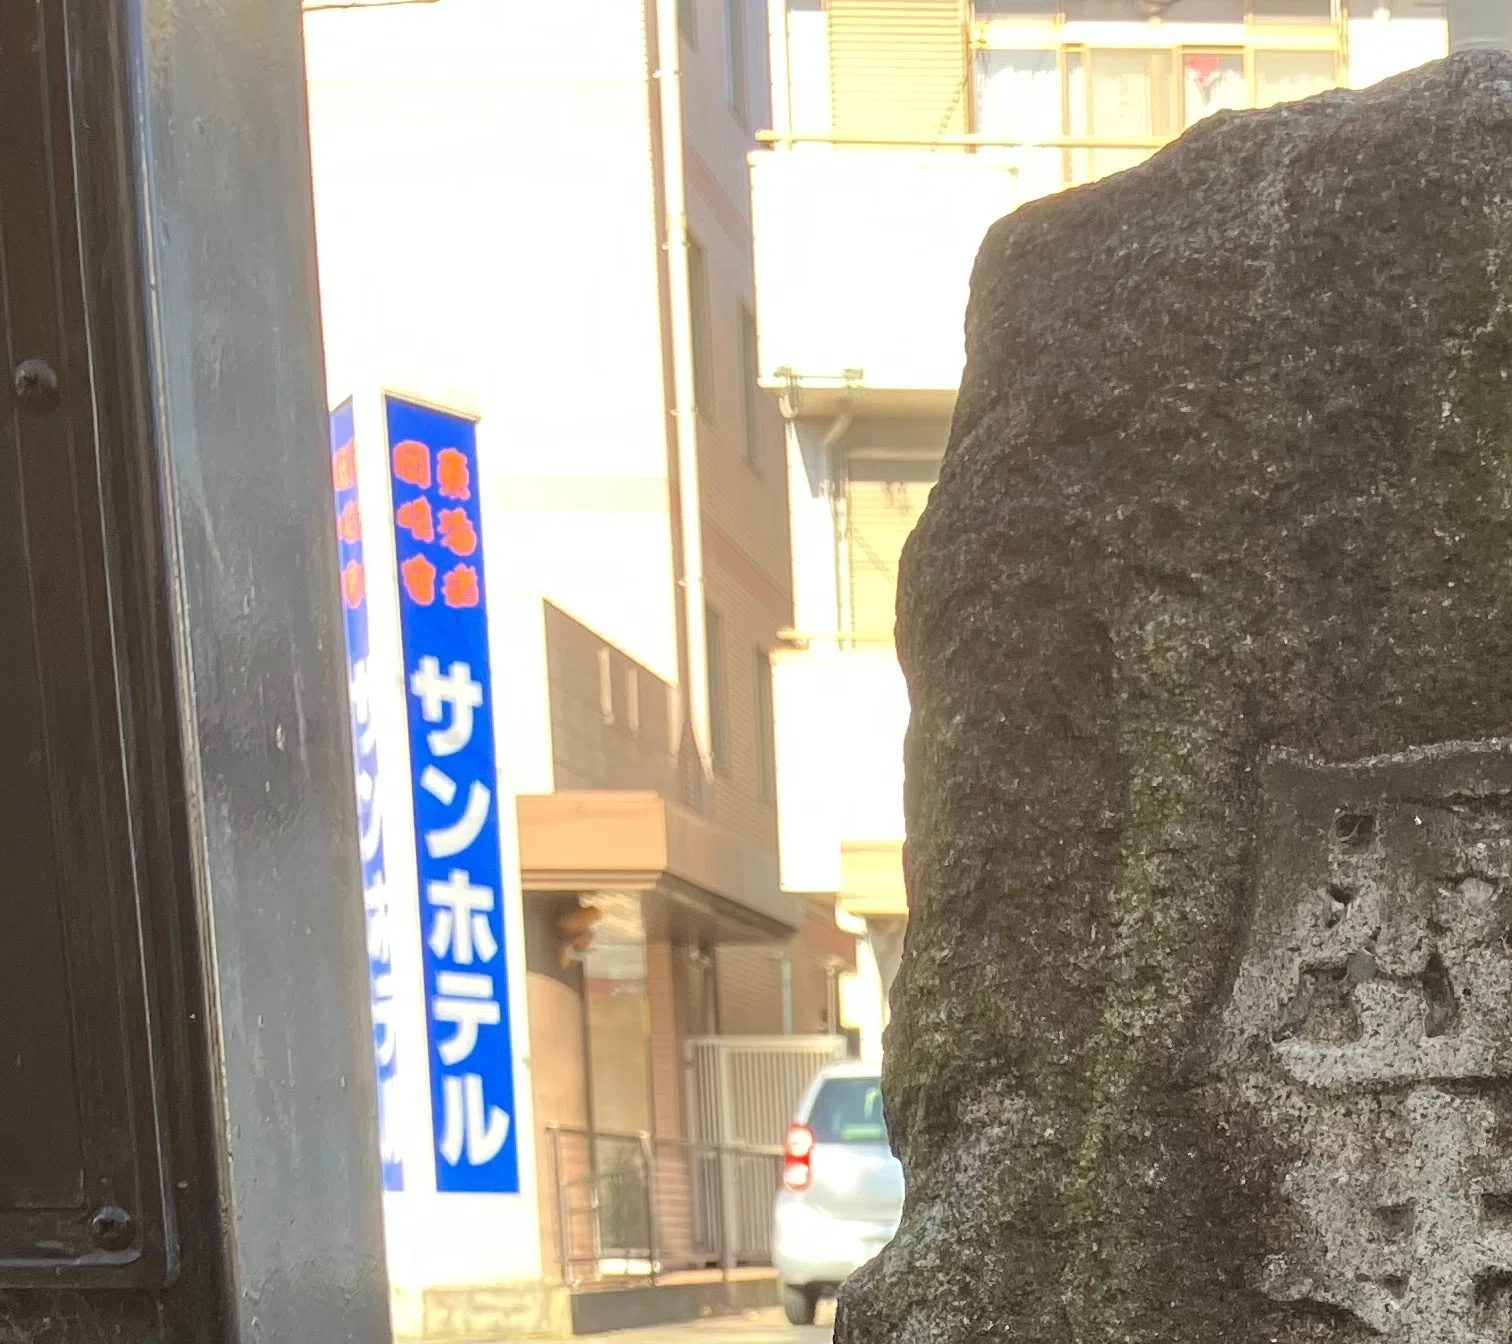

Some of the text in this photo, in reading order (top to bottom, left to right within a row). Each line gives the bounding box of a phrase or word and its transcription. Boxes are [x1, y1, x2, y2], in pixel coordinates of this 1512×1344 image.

[411, 654, 510, 1167] サンホテル
